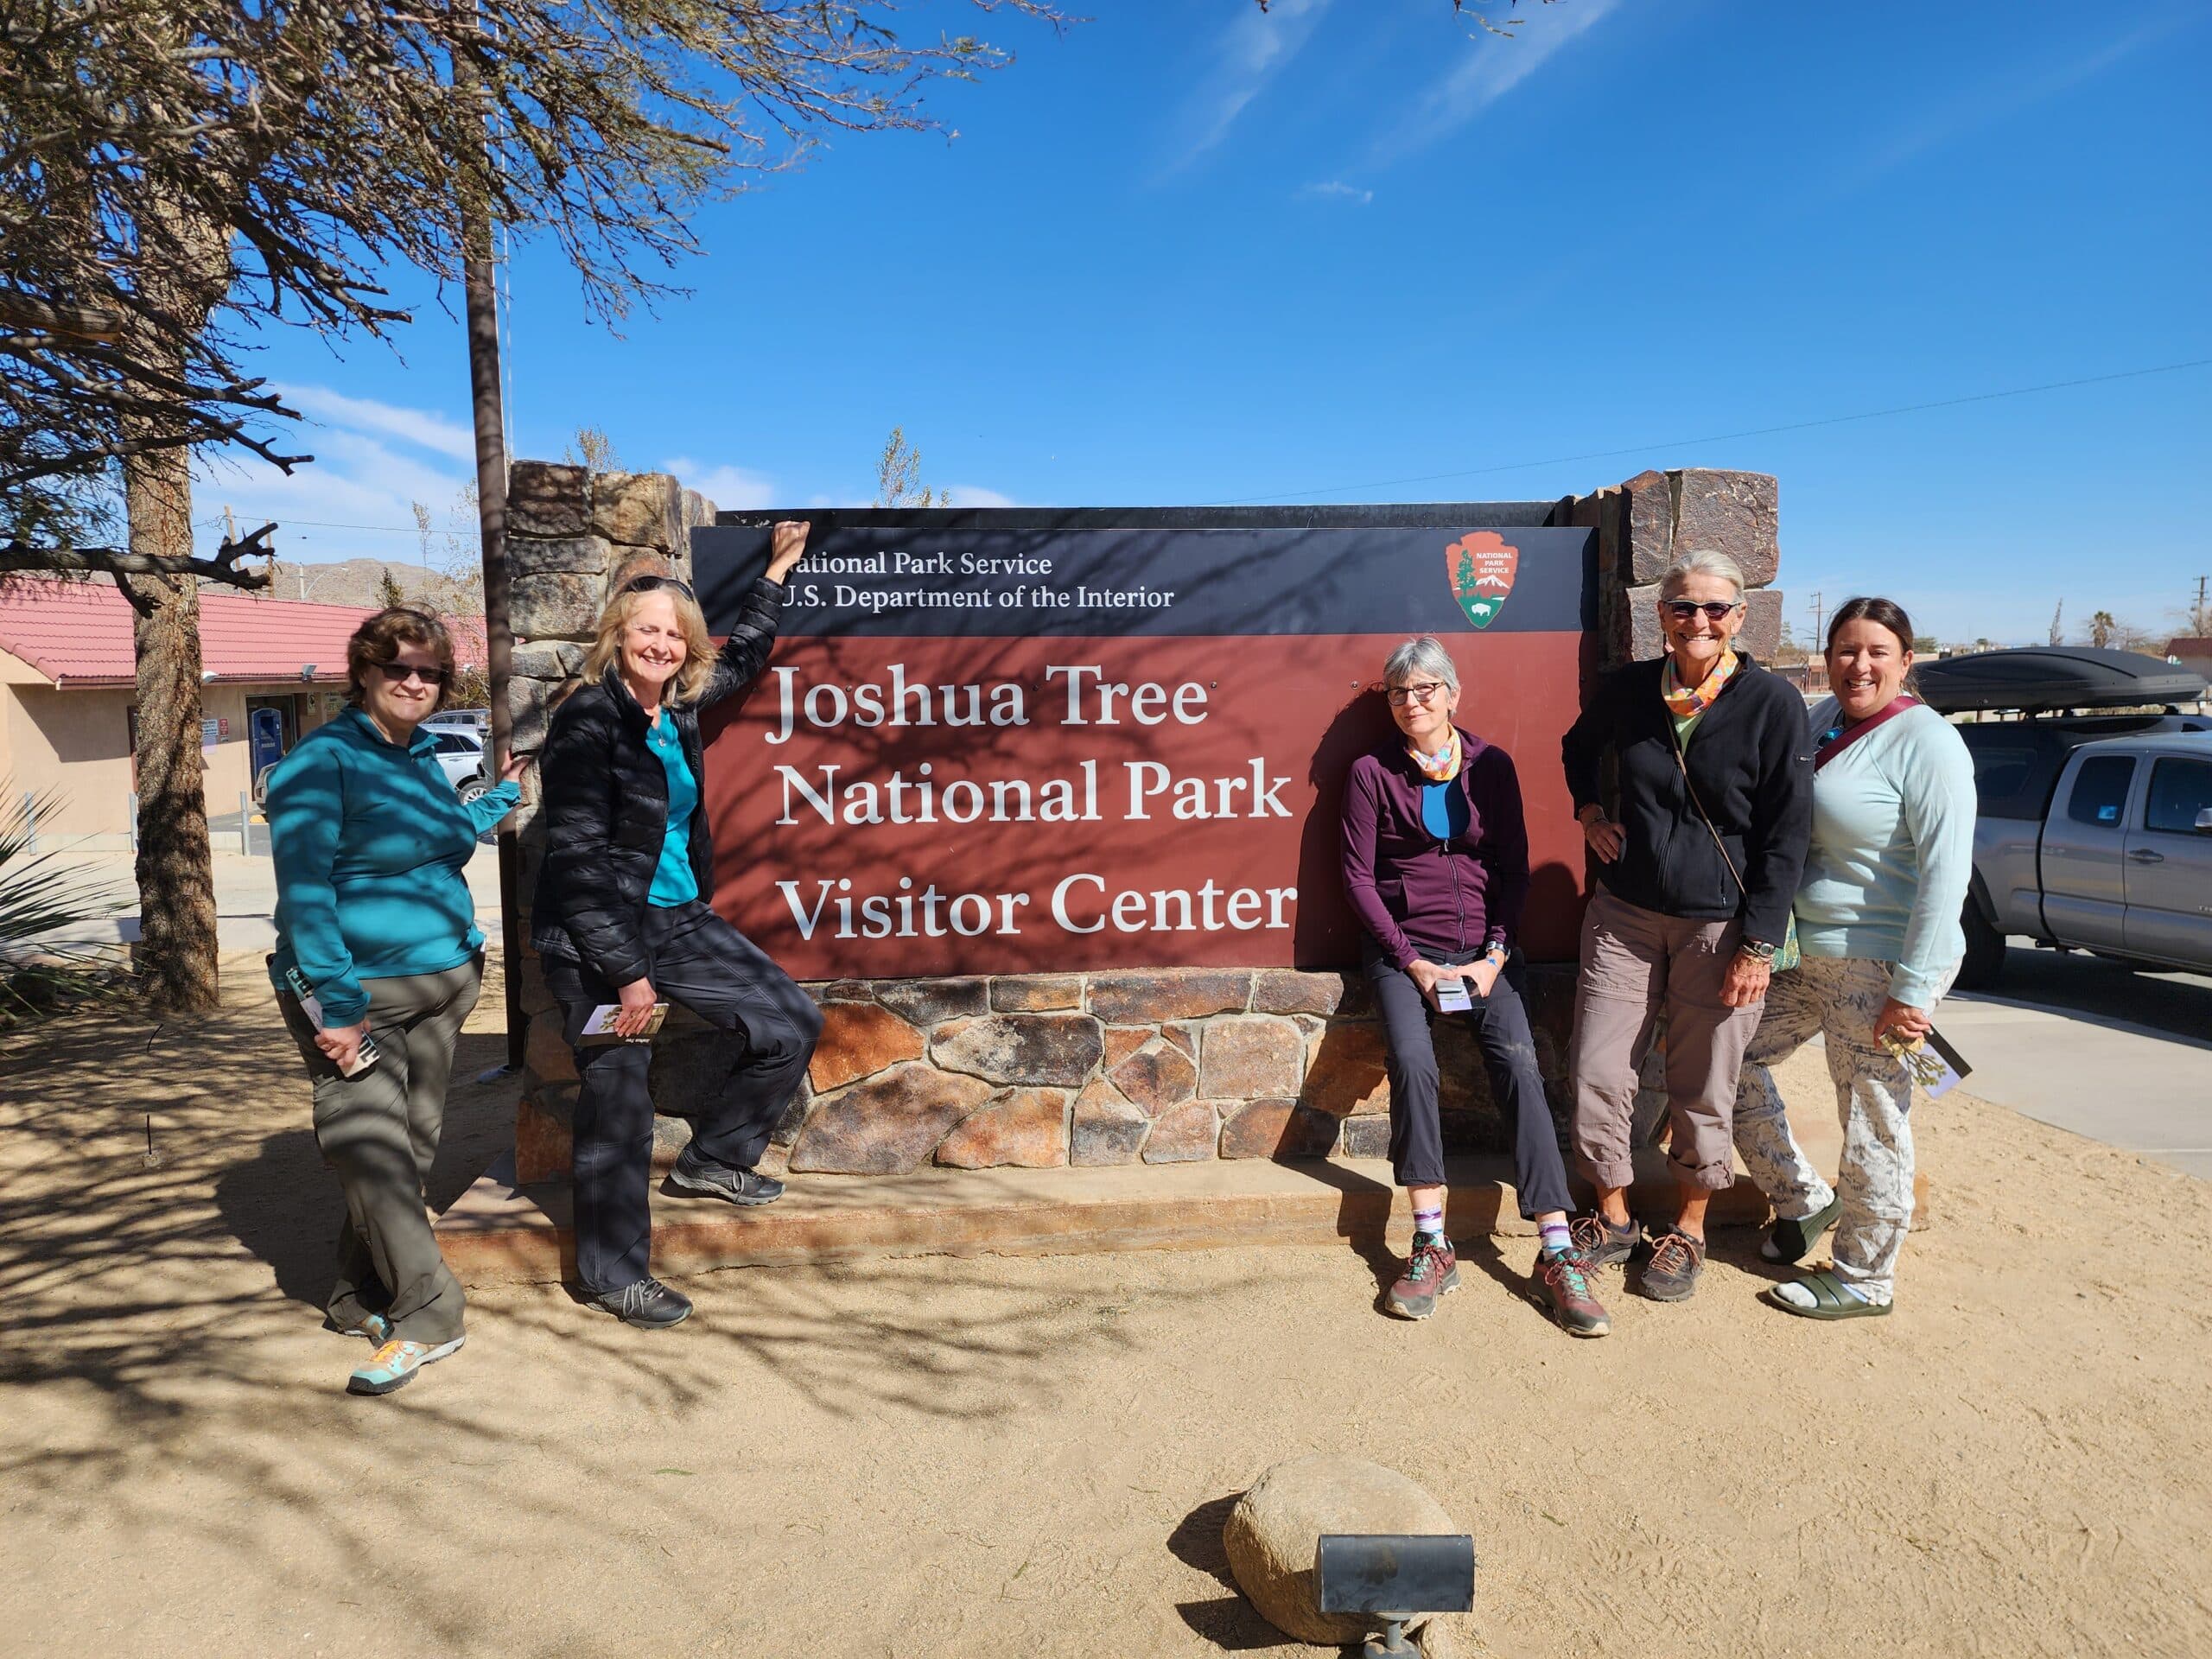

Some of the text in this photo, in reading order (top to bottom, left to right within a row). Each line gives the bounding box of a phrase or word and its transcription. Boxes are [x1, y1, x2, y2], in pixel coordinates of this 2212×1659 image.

[790, 551, 1052, 575] ational Park Service
[835, 585, 993, 613] Department
[999, 585, 1027, 607] of
[1031, 585, 1071, 607] the
[1077, 586, 1175, 607] Interior
[764, 664, 1208, 744] Joshua Tree
[774, 756, 1294, 825] National Park
[776, 874, 1298, 940] Visitor Center
